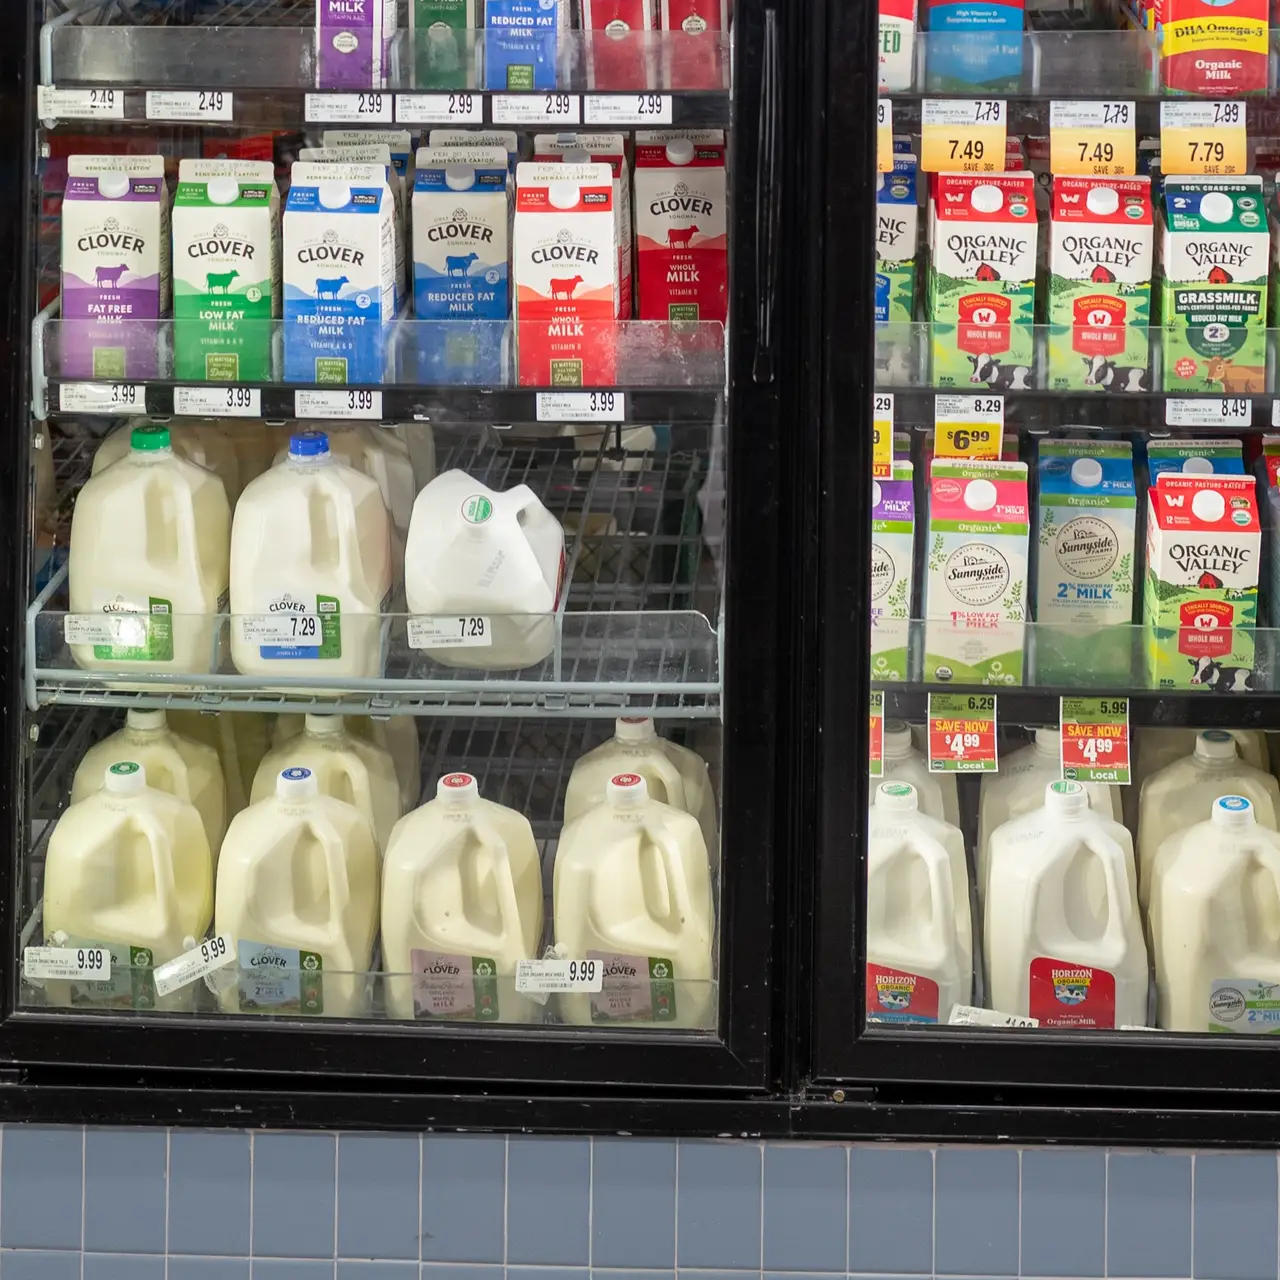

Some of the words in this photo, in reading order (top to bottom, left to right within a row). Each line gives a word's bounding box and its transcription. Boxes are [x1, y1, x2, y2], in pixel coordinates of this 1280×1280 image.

[328, 2, 364, 12] MILK
[492, 17, 533, 26] REDUCED
[537, 17, 552, 26] FAT
[510, 28, 533, 37] MILK
[199, 93, 223, 111] 2.49
[358, 94, 382, 113] 2.99
[546, 96, 569, 114] 2.99
[949, 140, 984, 159] 7.49
[1188, 142, 1224, 162] 7.79
[964, 163, 983, 172] SAVE
[650, 200, 712, 217] CLOVER
[78, 235, 145, 254] CLOVER
[188, 241, 255, 260] CLOVER
[947, 235, 1027, 253] ORGANIC
[954, 248, 1019, 266] VALLEY
[667, 271, 699, 282] MILK
[200, 310, 218, 319] LOW
[222, 311, 244, 319] FAT
[209, 322, 235, 331] MILK
[112, 386, 135, 402] 3.99
[348, 391, 372, 410] 3.99
[590, 393, 614, 411] 3.99
[974, 400, 1001, 413] 8.29
[1221, 398, 1247, 417] 8.49
[948, 565, 1005, 582] Sunnyside
[1077, 588, 1112, 599] MILK
[269, 602, 306, 613] CLOVER
[290, 618, 316, 636] 7.29
[968, 697, 994, 710] 6.29
[935, 721, 960, 733] SAVE
[964, 722, 989, 733] NOW
[957, 761, 985, 770] Local
[201, 936, 227, 963] 9.99
[251, 957, 287, 967] CLOVER
[569, 961, 595, 981] 9.99
[1052, 970, 1092, 979] HORIZON
